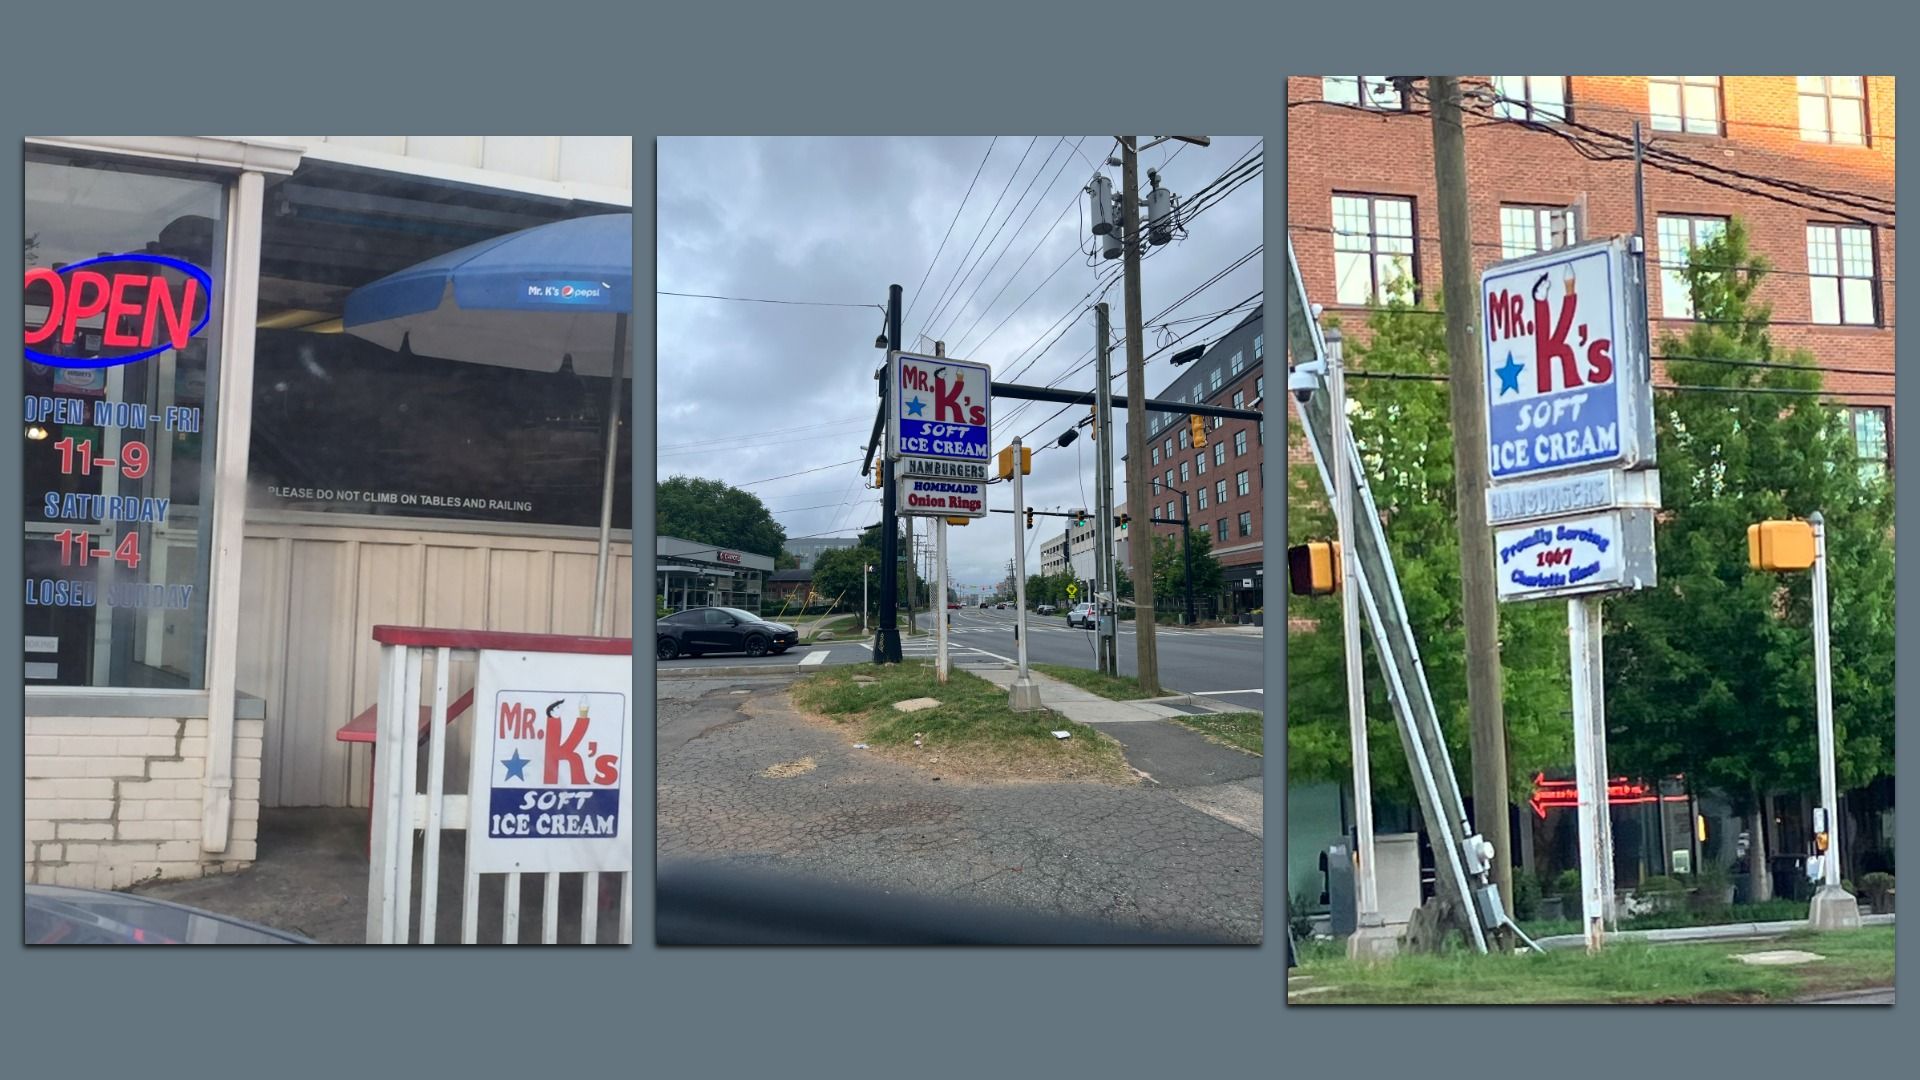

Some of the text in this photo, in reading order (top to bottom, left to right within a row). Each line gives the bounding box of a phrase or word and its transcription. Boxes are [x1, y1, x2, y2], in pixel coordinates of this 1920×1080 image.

[528, 286, 600, 298] Mr. K's pepsi
[25, 267, 198, 349] OPEN
[1489, 288, 1614, 393] MR. K's
[25, 395, 84, 425] OPEN
[902, 364, 986, 426] MR. K's
[1515, 394, 1588, 431] SOFT
[920, 423, 970, 438] SOFT
[900, 437, 988, 457] ICE CREAM
[1492, 422, 1617, 472] ICE CREAM
[909, 460, 985, 478] HAMBURGERS
[268, 486, 533, 512] PLEASE DO NOT CLIMB ON TABLES AND RAILING
[908, 493, 982, 512] Onion Rings
[914, 481, 978, 494] HOMEMADE
[1492, 481, 1605, 518] HAMBURGERS
[44, 492, 171, 522] SATURDAY
[25, 579, 194, 609] LOSED SUNDAY
[499, 702, 619, 786] MR. K's
[519, 791, 594, 810] SOFT
[492, 813, 615, 835] ICE CREAM
